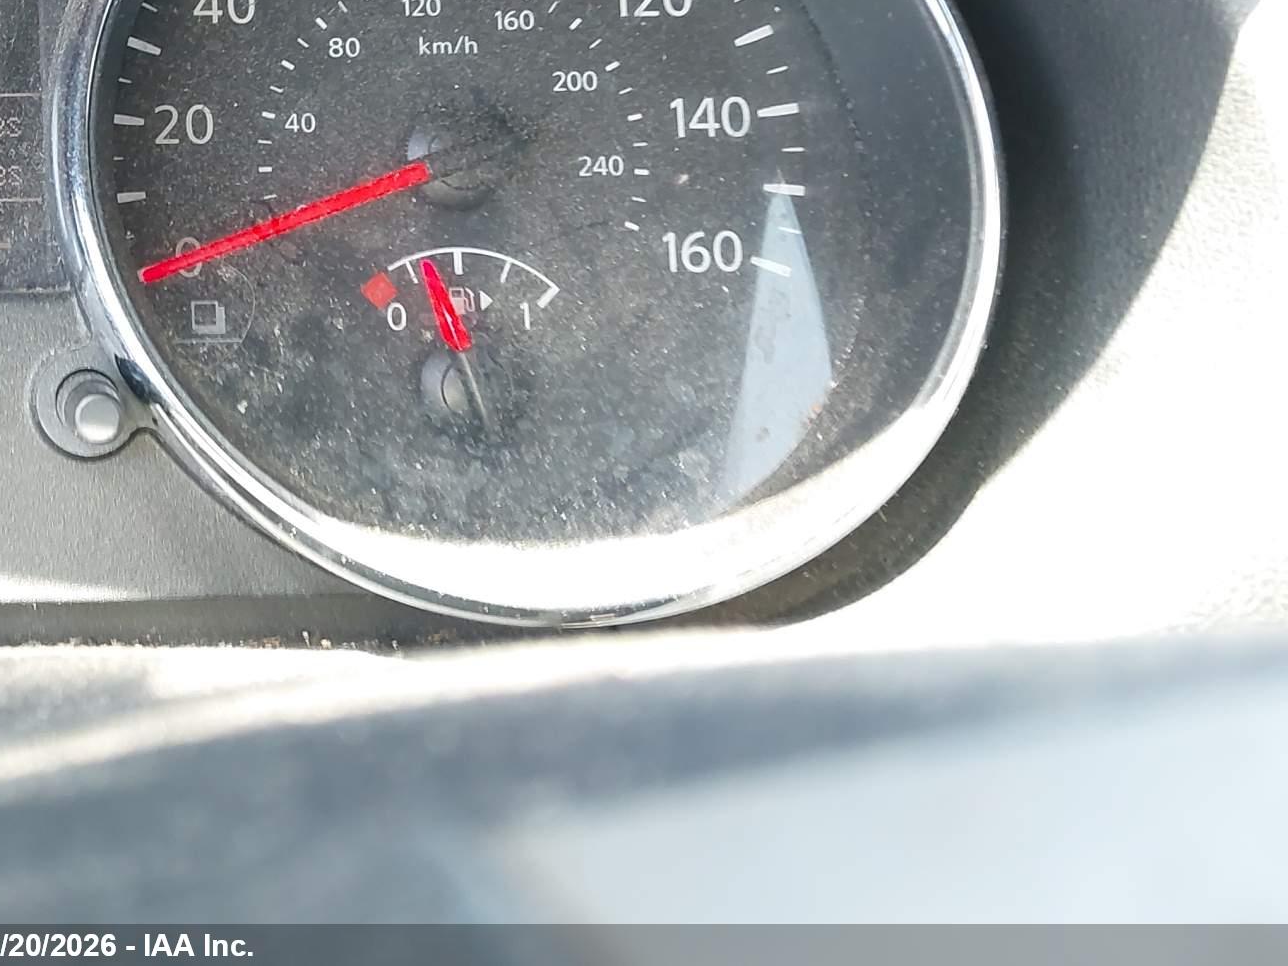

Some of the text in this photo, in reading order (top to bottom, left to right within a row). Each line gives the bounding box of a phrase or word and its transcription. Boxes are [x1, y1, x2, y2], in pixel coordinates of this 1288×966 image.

[495, 9, 536, 32] 160
[328, 37, 361, 60] 80
[418, 35, 479, 56] km/h
[553, 71, 598, 93] 200
[154, 104, 215, 146] 20
[284, 113, 316, 133] 40
[670, 95, 752, 138] 140
[578, 155, 624, 177] 240
[662, 230, 744, 274] 160
[387, 302, 408, 332] 0
[520, 302, 531, 330] 1
